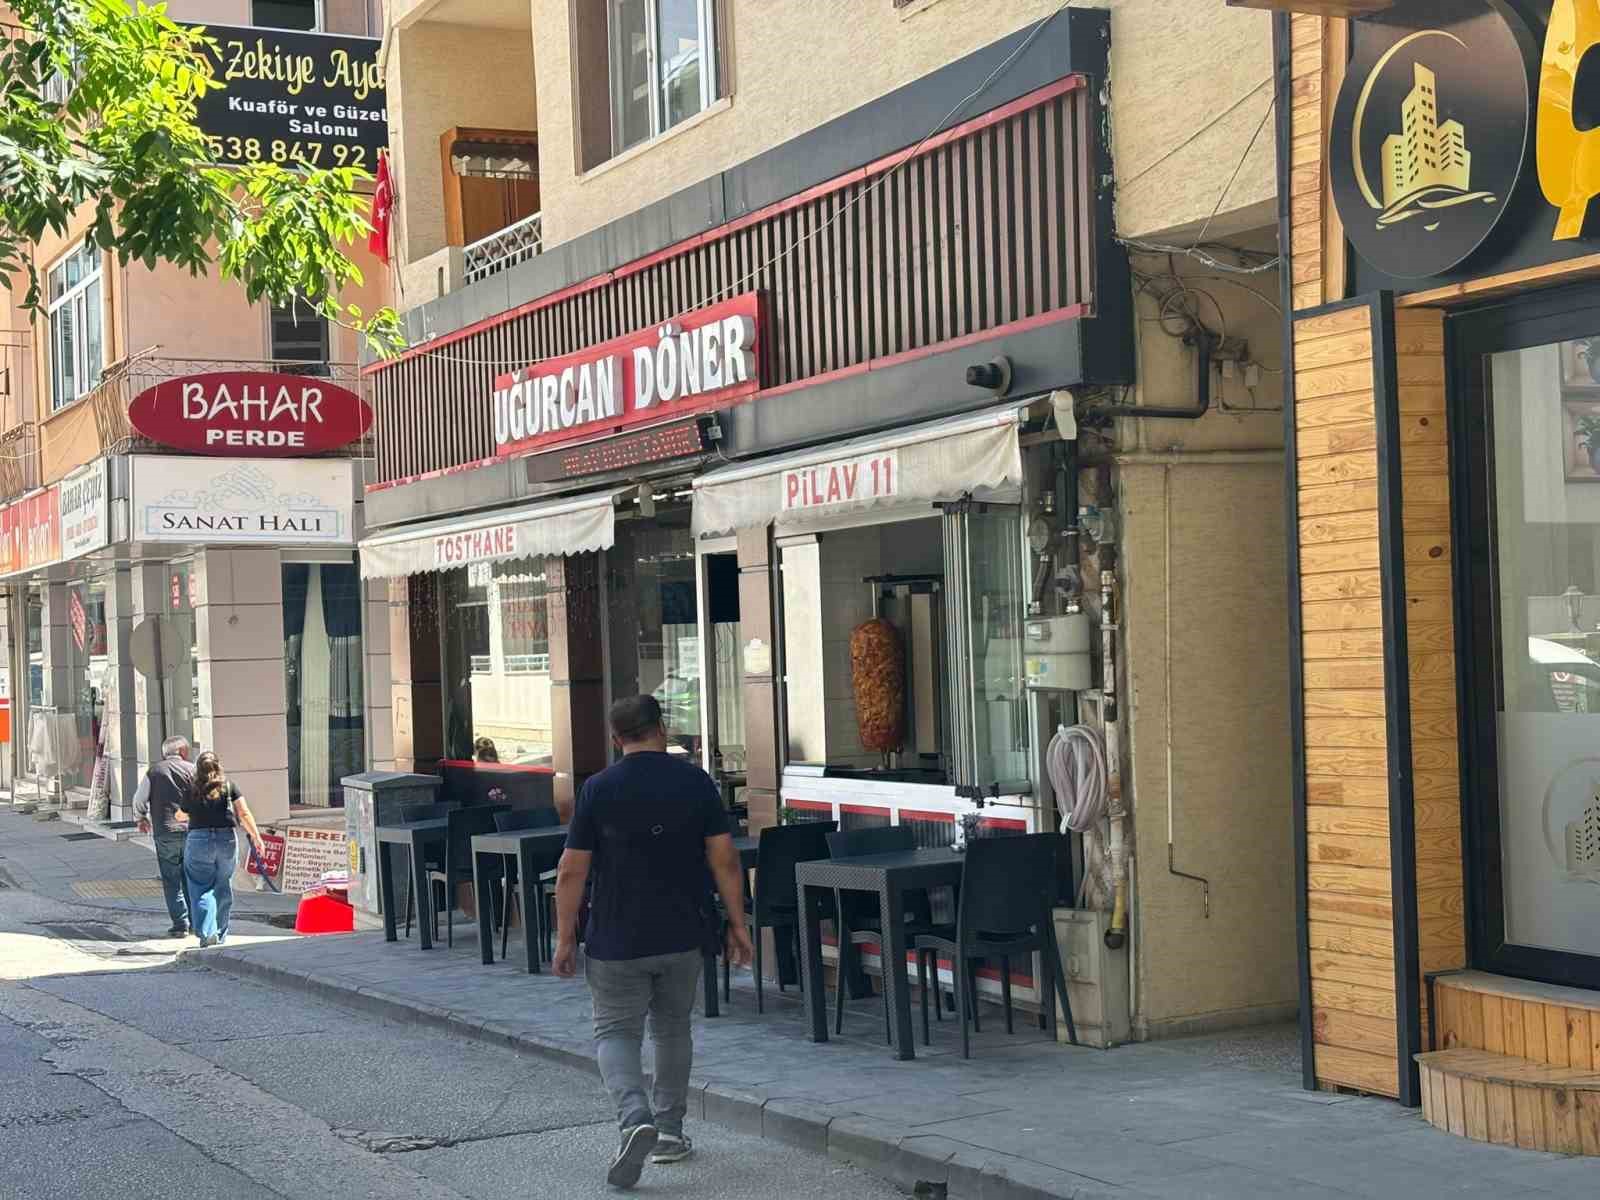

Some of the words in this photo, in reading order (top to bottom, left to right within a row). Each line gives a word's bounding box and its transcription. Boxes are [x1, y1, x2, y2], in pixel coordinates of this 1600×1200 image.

[225, 38, 315, 95] Zekiye
[228, 97, 298, 115] Kuaför
[305, 106, 327, 117] ve
[289, 119, 358, 137] Salonu
[271, 140, 322, 164] 847
[332, 144, 366, 167] 92
[493, 354, 617, 444] UĞURCAN
[633, 314, 755, 410] DÖNER
[182, 382, 324, 424] BAHAR
[205, 429, 305, 447] PERDE
[870, 457, 891, 495] 11
[163, 512, 248, 530] SANAT
[259, 515, 321, 531] HALI
[436, 527, 513, 563] TOSTHANE
